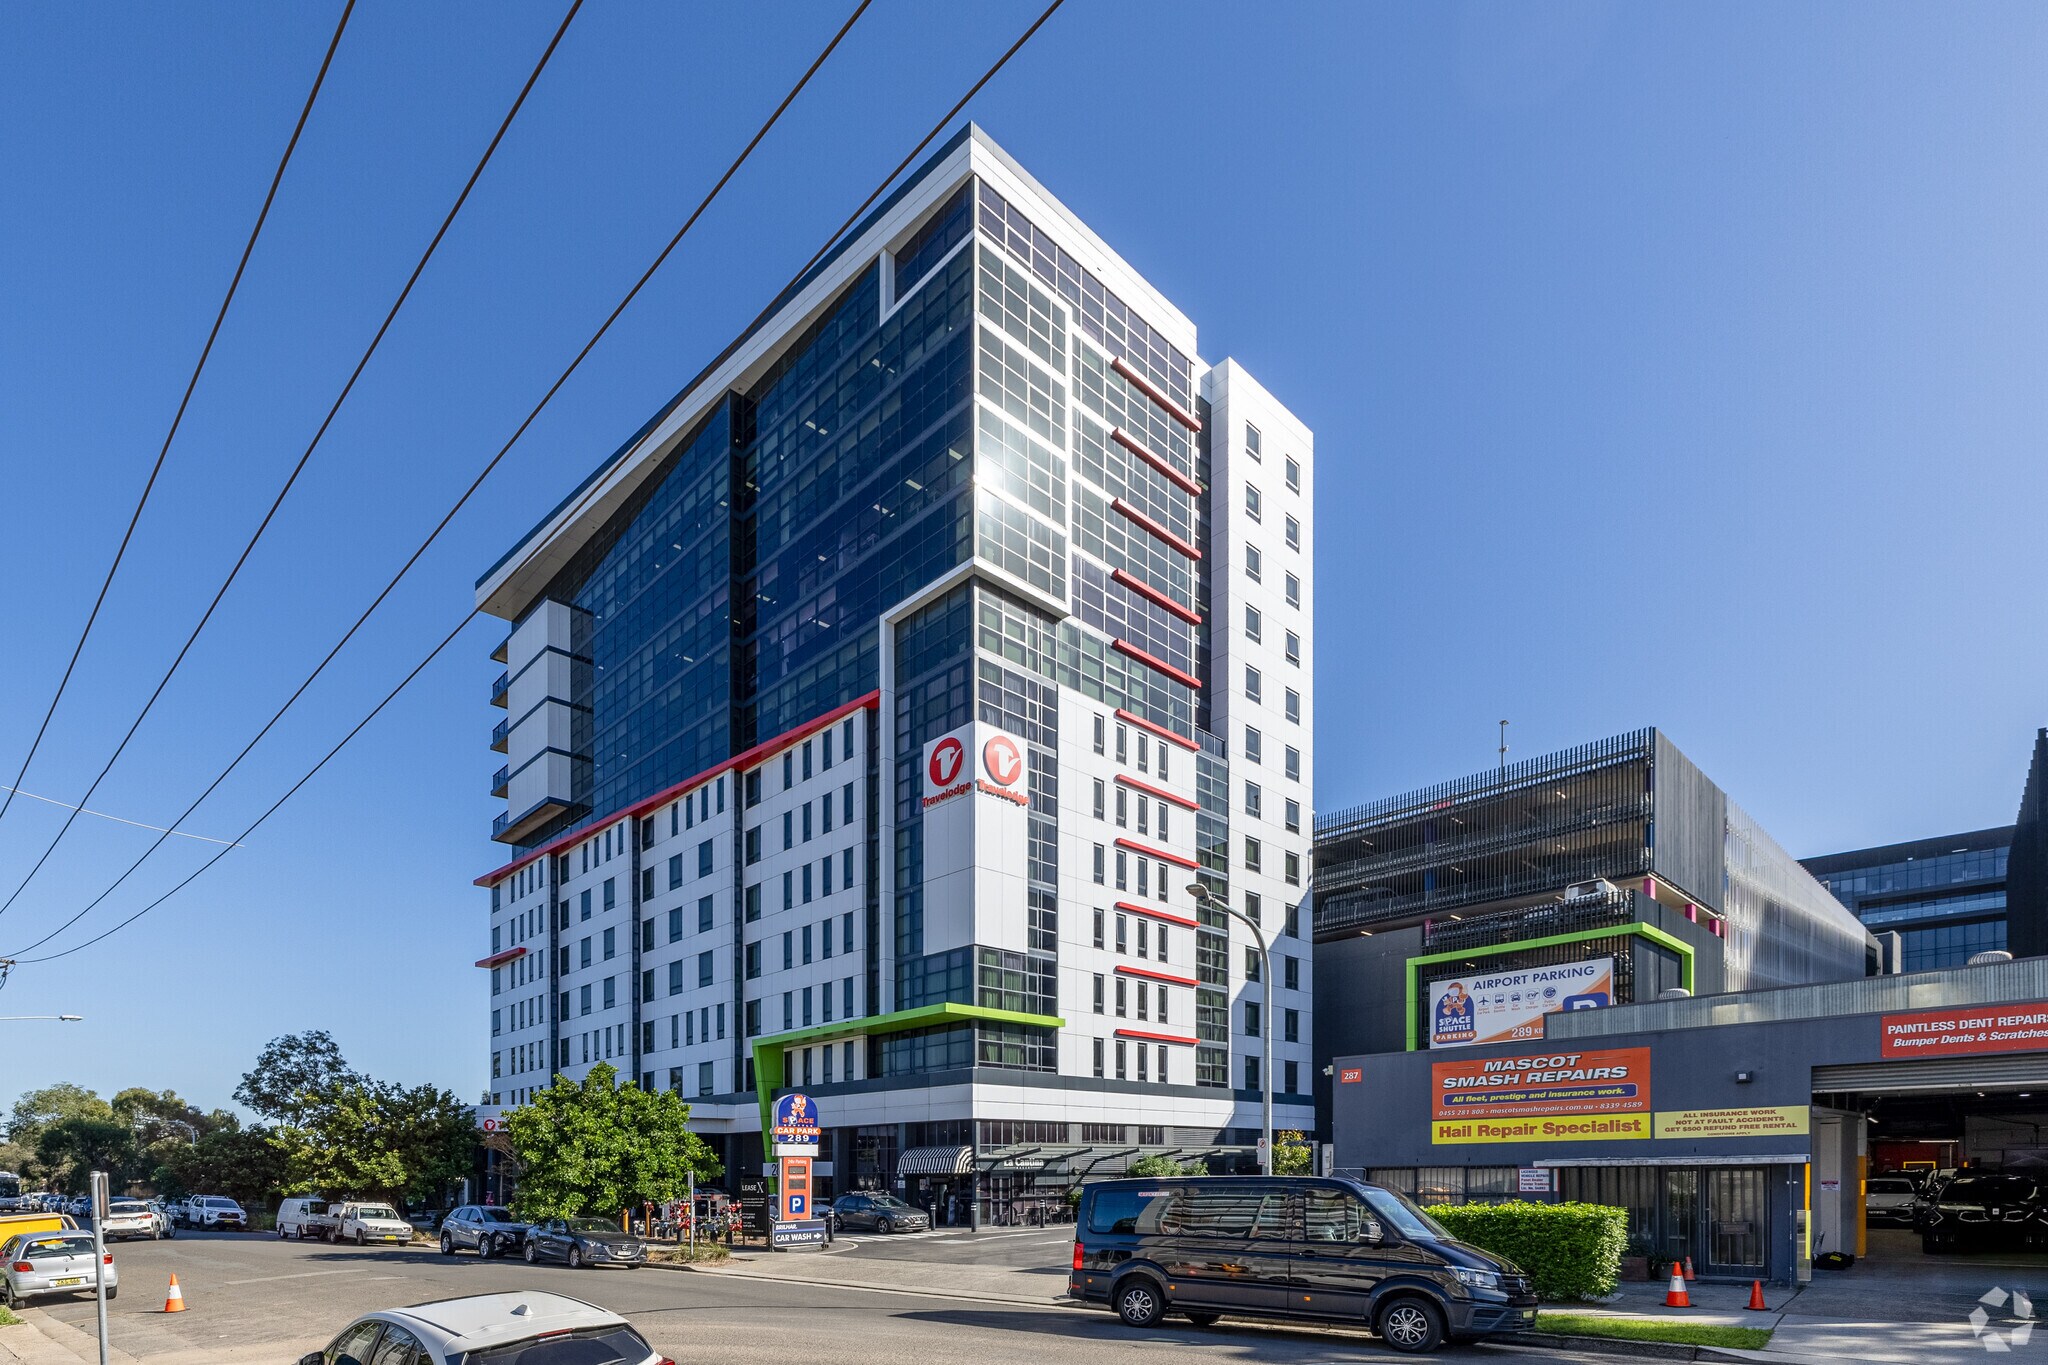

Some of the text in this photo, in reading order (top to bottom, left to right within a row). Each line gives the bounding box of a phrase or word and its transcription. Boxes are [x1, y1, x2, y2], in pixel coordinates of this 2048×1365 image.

[922, 782, 972, 808] Travelodge
[976, 778, 1030, 806] Travelodge
[1473, 966, 1594, 990] AIRPORT PARKING
[1439, 1016, 1471, 1026] SPACE
[1888, 1014, 2048, 1034] PAINTLESS DENT REPAIR
[1439, 1024, 1470, 1032] SHUTTLE
[1512, 1026, 1532, 1038] 289
[1893, 1037, 1939, 1047] Bumper
[1941, 1034, 1974, 1044] Dents
[1977, 1033, 1986, 1041] &
[1484, 1054, 1582, 1072] MASCOT
[1344, 1072, 1358, 1080] 287
[1443, 1066, 1628, 1089] SMASH REPAIRS
[1490, 1093, 1526, 1102] prestige
[1548, 1089, 1595, 1098] insurance
[1490, 1104, 1594, 1114] mascotsmashrepairs.com.au
[782, 1116, 814, 1124] SPACE
[1439, 1119, 1642, 1138] Hail Repair Specialist
[1015, 1158, 1044, 1166] Cantina
[792, 1198, 801, 1211] P
